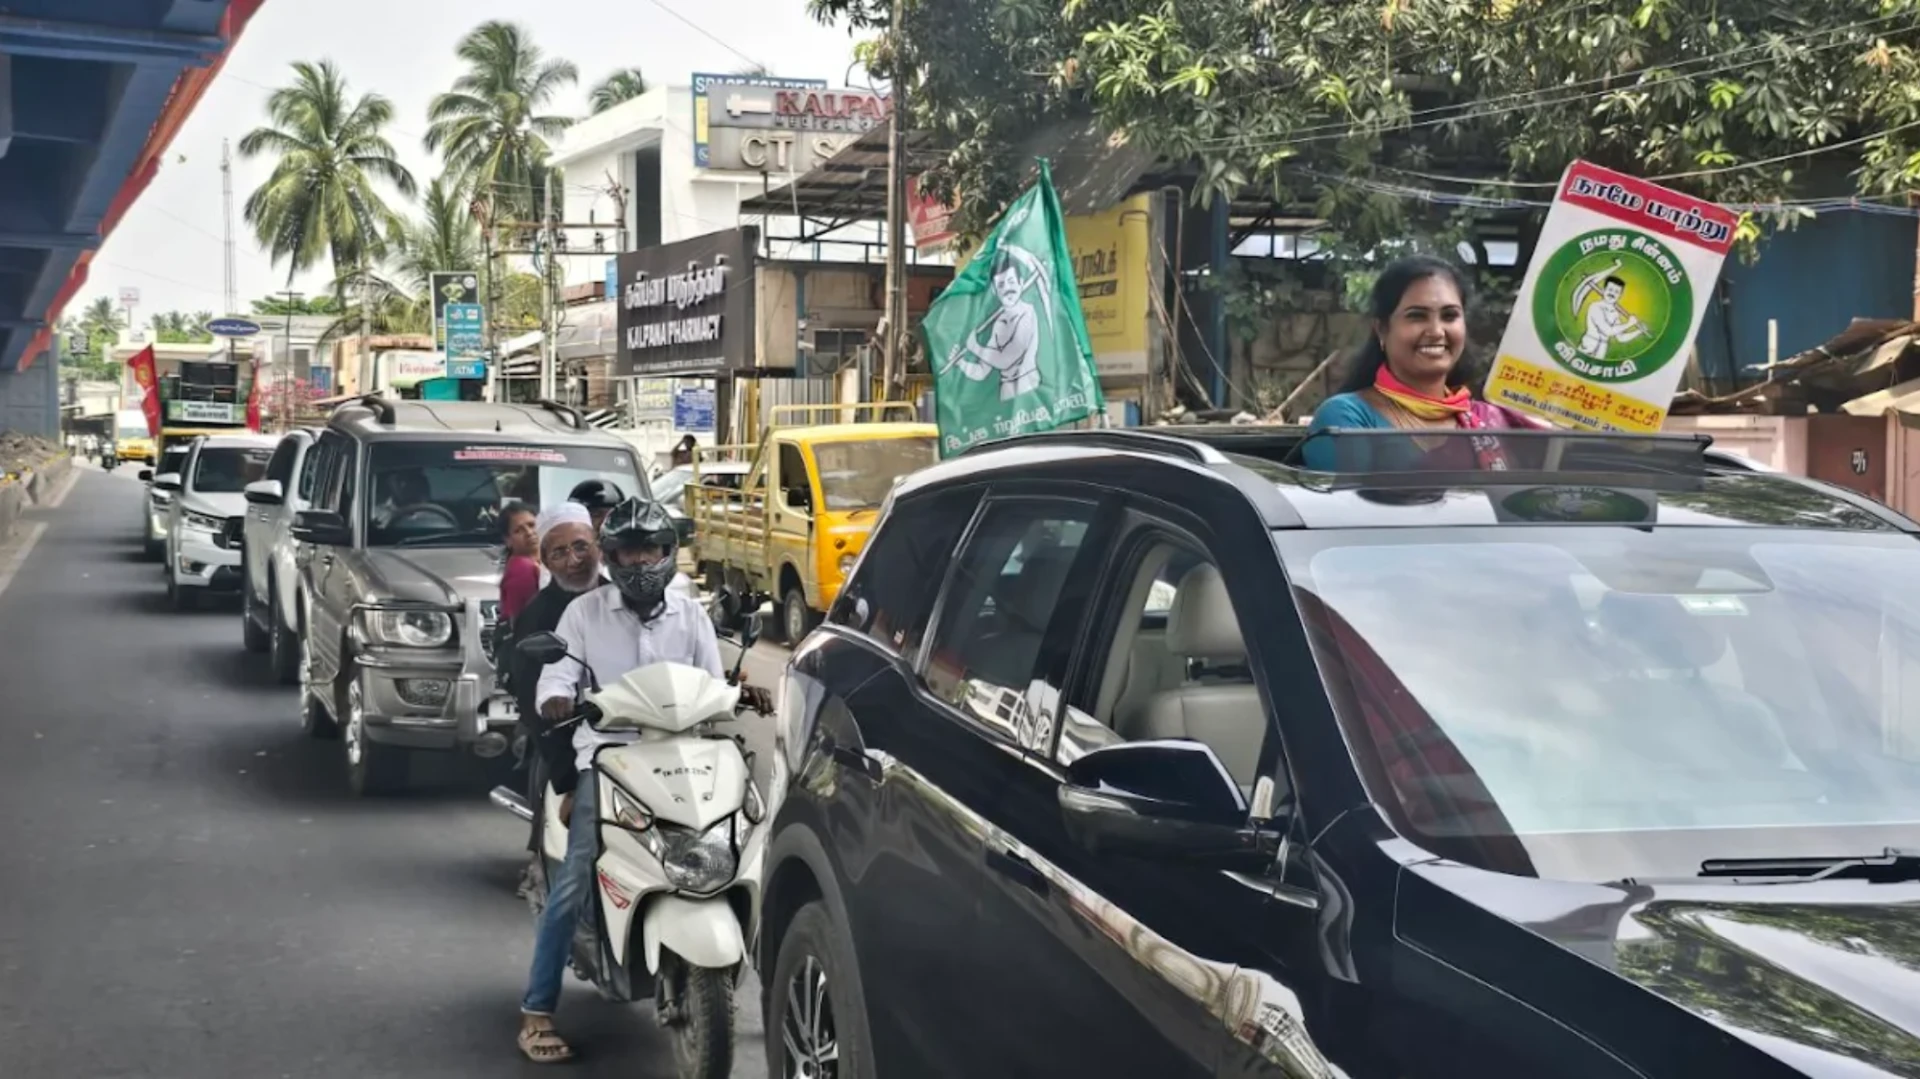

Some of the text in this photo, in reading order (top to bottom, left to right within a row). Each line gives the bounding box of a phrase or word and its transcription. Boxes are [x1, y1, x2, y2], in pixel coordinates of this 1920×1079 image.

[740, 131, 794, 168] CT
[1567, 176, 1729, 242] நாமே மாற்று
[1579, 234, 1682, 286] நமது சின்னம்
[626, 314, 721, 350] KALPANA PHARMACY
[1554, 341, 1637, 379] விவசாயி
[1498, 362, 1545, 388] நாம்
[1548, 379, 1613, 412] தமிழர்
[1614, 404, 1660, 430] கட்சி
